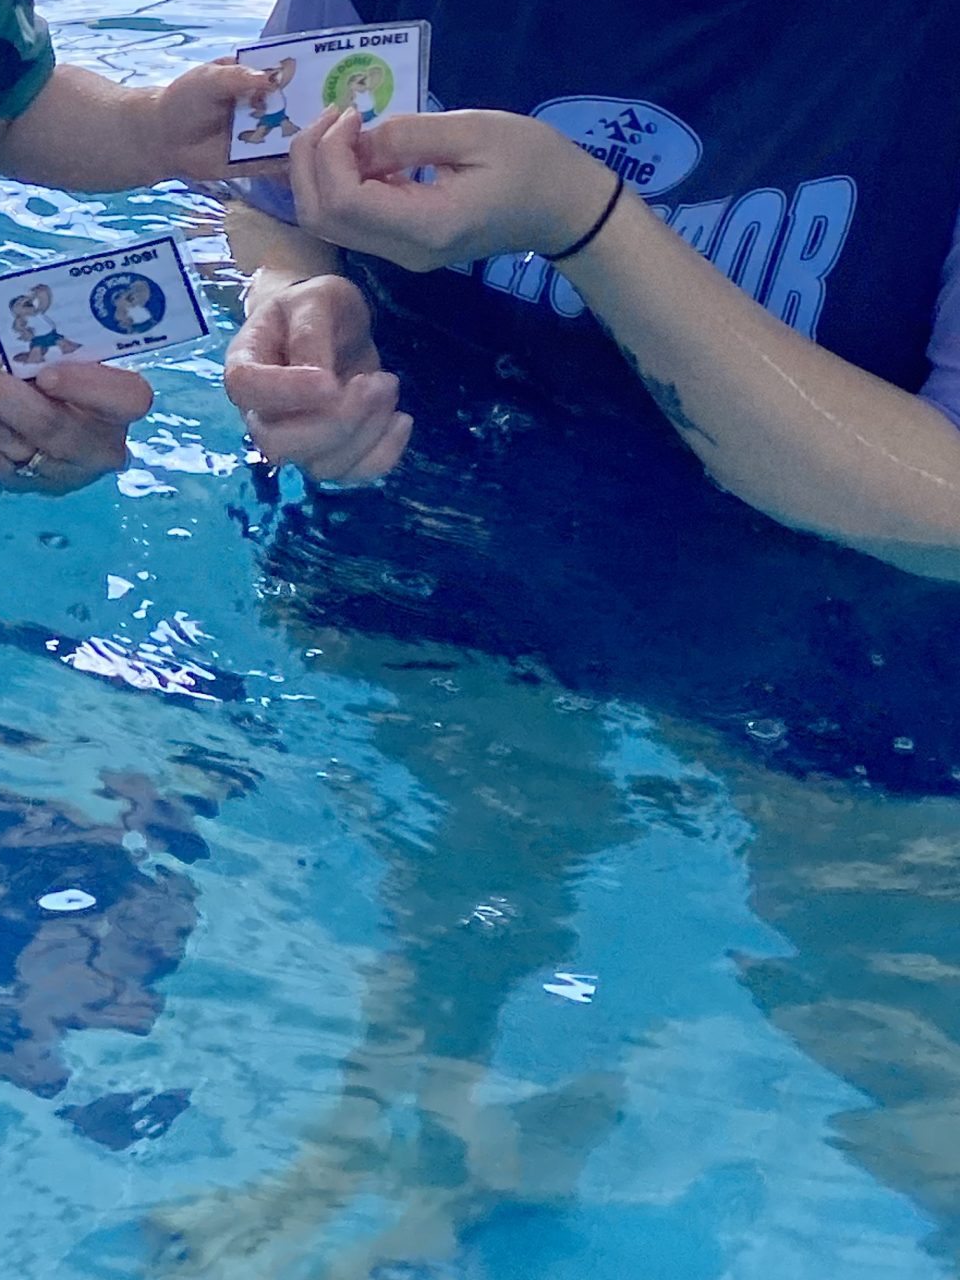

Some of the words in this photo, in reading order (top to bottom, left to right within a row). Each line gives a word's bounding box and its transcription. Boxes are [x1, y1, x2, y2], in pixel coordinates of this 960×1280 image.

[314, 38, 355, 54] WELL
[359, 32, 409, 48] DONE!
[69, 259, 116, 277] GOOD
[121, 249, 159, 267] JOB!
